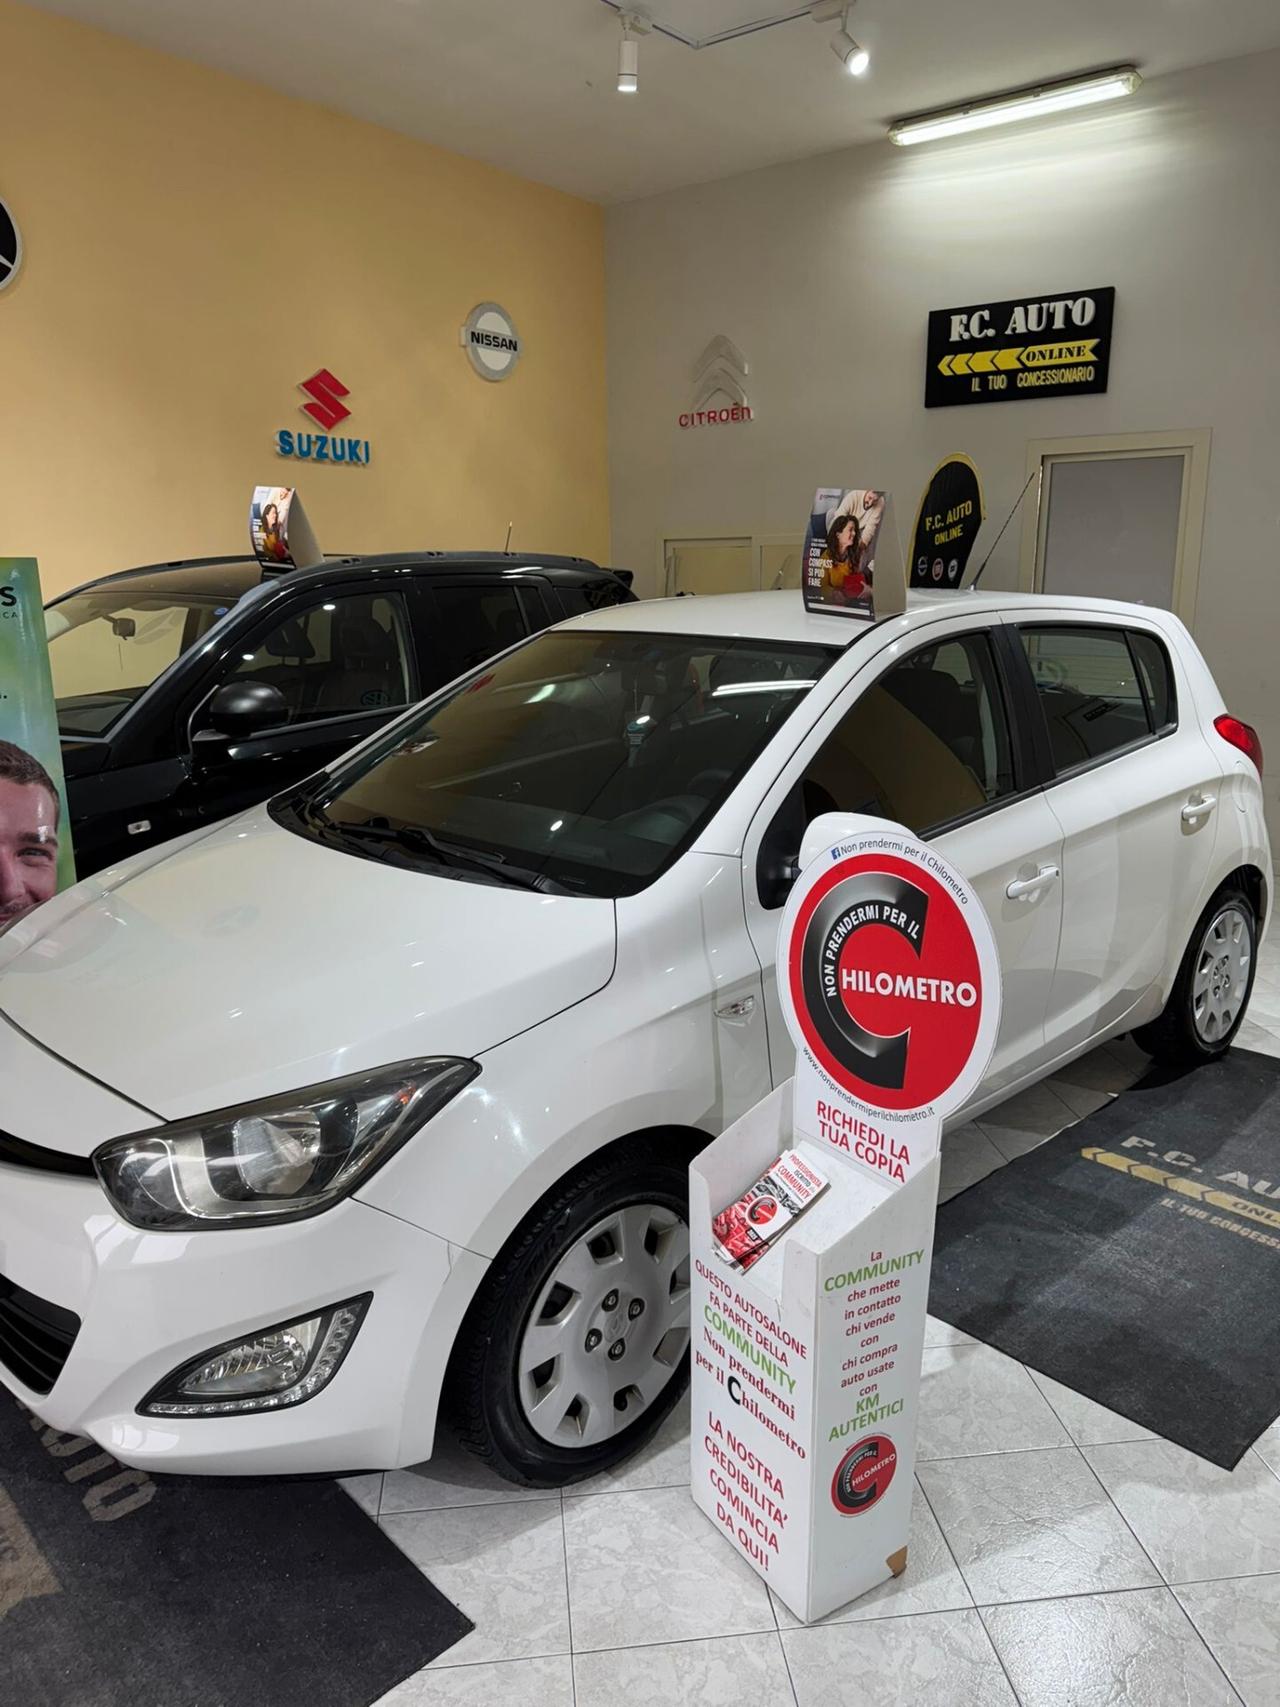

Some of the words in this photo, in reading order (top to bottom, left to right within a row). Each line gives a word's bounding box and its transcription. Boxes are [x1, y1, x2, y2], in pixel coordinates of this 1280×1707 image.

[949, 310, 996, 342] F.C.
[1005, 297, 1096, 335] AUTO
[470, 331, 517, 352] NISSAN
[1026, 345, 1086, 362] ONLINE
[971, 378, 981, 392] IL
[988, 375, 1007, 390] TUO
[1017, 366, 1095, 388] CONCESSIONARIO
[277, 430, 370, 464] SUZUKI
[925, 515, 944, 531] F.C.
[946, 500, 972, 524] AUTO
[934, 525, 963, 545] ONLINE
[808, 558, 833, 569] COMPASS
[809, 548, 821, 557] CON
[808, 568, 813, 577] SI
[808, 577, 821, 587] FARE
[840, 842, 857, 855] Non
[858, 838, 903, 851] prendermi
[904, 845, 920, 858] per
[920, 853, 927, 862] il
[927, 857, 969, 905] Chilometro
[826, 904, 879, 960] PRENDERMI
[883, 905, 906, 928] PER
[908, 920, 921, 939] IL
[824, 964, 837, 997] NON
[802, 1047, 936, 1123] www.nonprendermiperilchilometro.it
[816, 1100, 885, 1149] RICHIEDI
[889, 1139, 910, 1165] LA
[819, 1120, 850, 1151] TUA
[854, 1141, 905, 1183] COPIA
[777, 1165, 811, 1199] COMMUNITY
[1160, 1198, 1176, 1209] IL
[1178, 1203, 1209, 1220] TUO
[823, 1249, 925, 1292] COMMUNITY
[870, 1251, 882, 1262] La
[847, 1289, 866, 1303] che
[869, 1279, 901, 1296] mette
[695, 1259, 732, 1298] QUESTO
[734, 1294, 807, 1360] AUTOSALONE
[844, 1310, 855, 1320] in
[857, 1295, 902, 1316] contatto
[710, 1291, 721, 1310] FA
[723, 1303, 753, 1338] PARTE
[755, 1330, 789, 1367] DELLA
[845, 1323, 861, 1337] chi
[864, 1312, 896, 1331] vende
[704, 1304, 797, 1394] COMMUNITY
[841, 1358, 857, 1371] chi
[859, 1343, 898, 1365] compra
[860, 1335, 879, 1348] con
[703, 1326, 726, 1358] Non
[729, 1354, 796, 1421] prendermi
[841, 1372, 865, 1388] auto
[867, 1360, 895, 1378] usate
[696, 1350, 714, 1374] per
[716, 1367, 724, 1385] il
[727, 1376, 806, 1459] Chilometro
[855, 1393, 880, 1415] KM
[859, 1383, 878, 1397] con
[828, 1399, 904, 1442] AUTENTICI
[708, 1411, 723, 1440] LA
[727, 1430, 785, 1500] NOSTRA
[704, 1435, 789, 1530] CREDIBILITA'
[710, 1469, 780, 1554] COMINCIA
[717, 1502, 735, 1535] DA
[738, 1527, 770, 1571] QUI!
